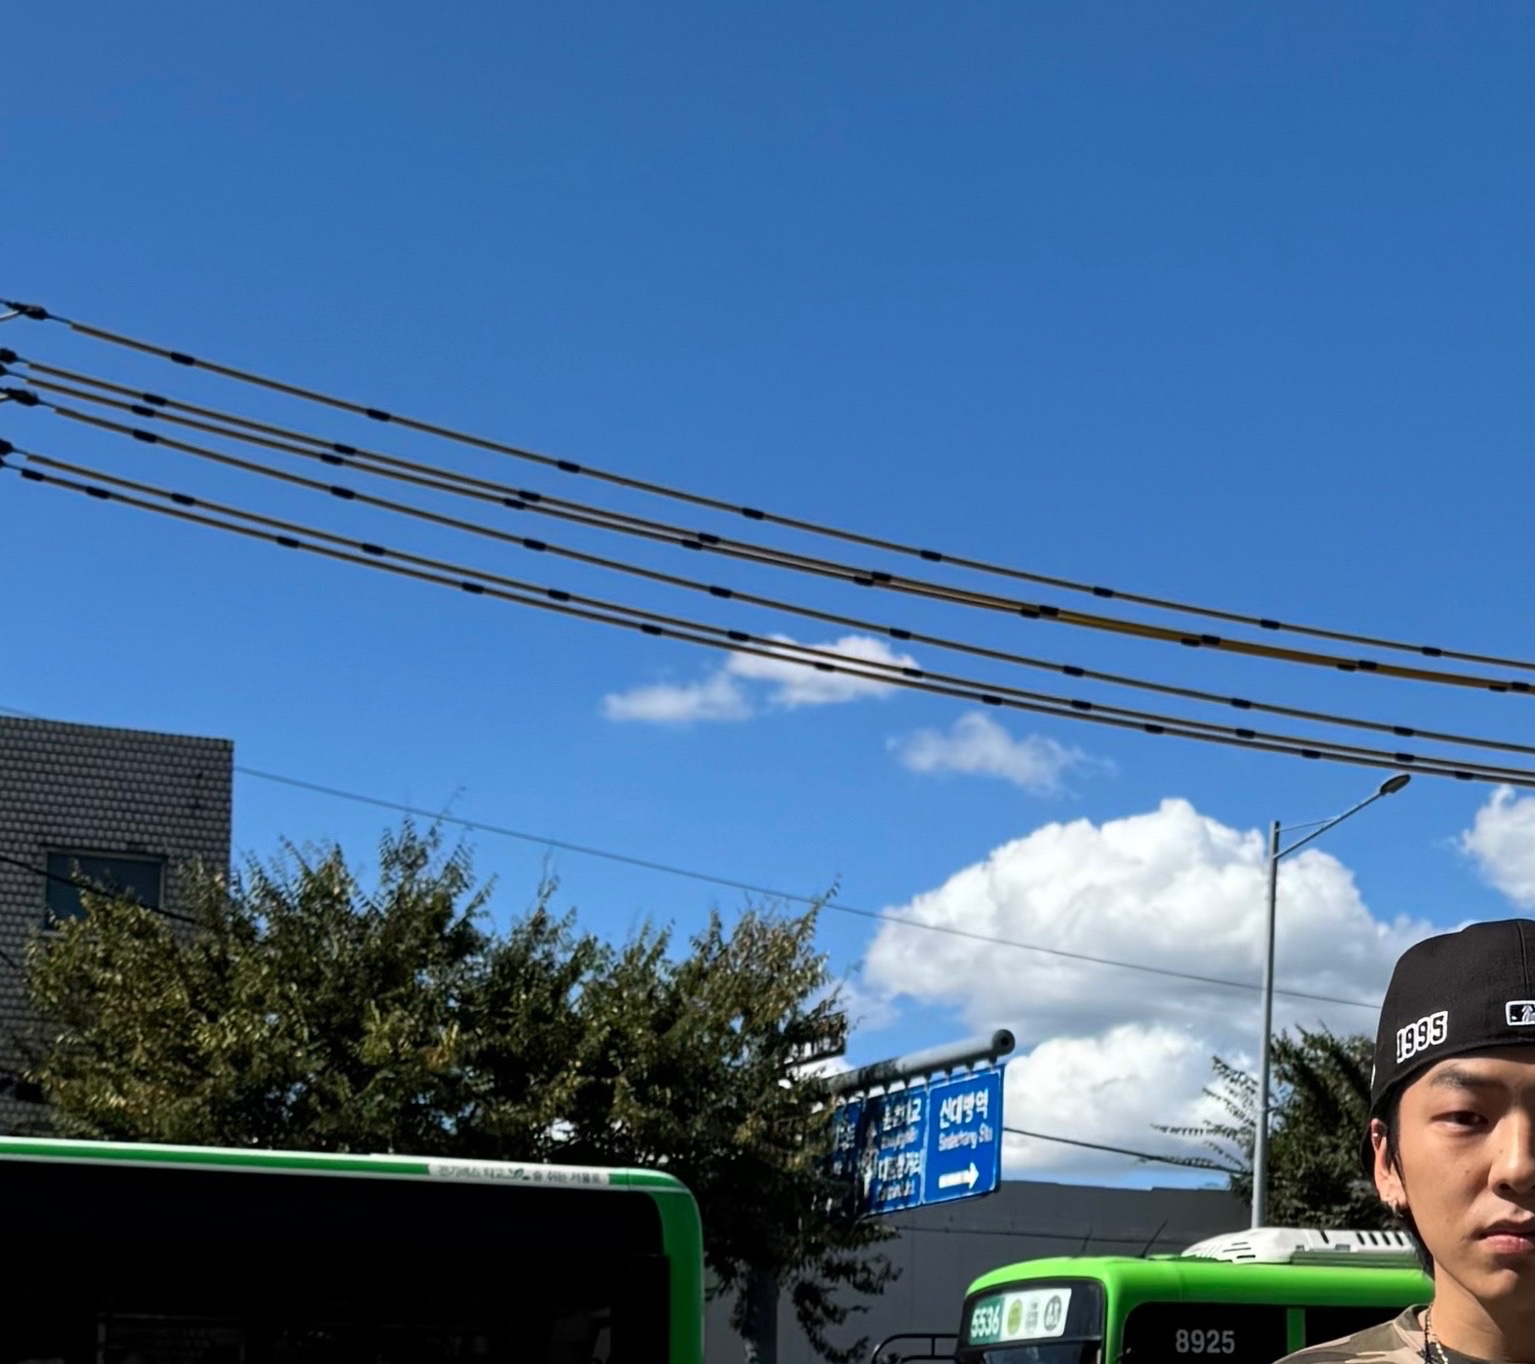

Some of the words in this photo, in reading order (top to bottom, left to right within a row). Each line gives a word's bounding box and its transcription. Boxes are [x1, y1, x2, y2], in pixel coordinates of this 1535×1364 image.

[1396, 1010, 1449, 1064] 1995
[939, 1088, 989, 1130] 신대방역
[970, 1305, 1000, 1339] 5536
[1175, 1329, 1235, 1354] 8925
